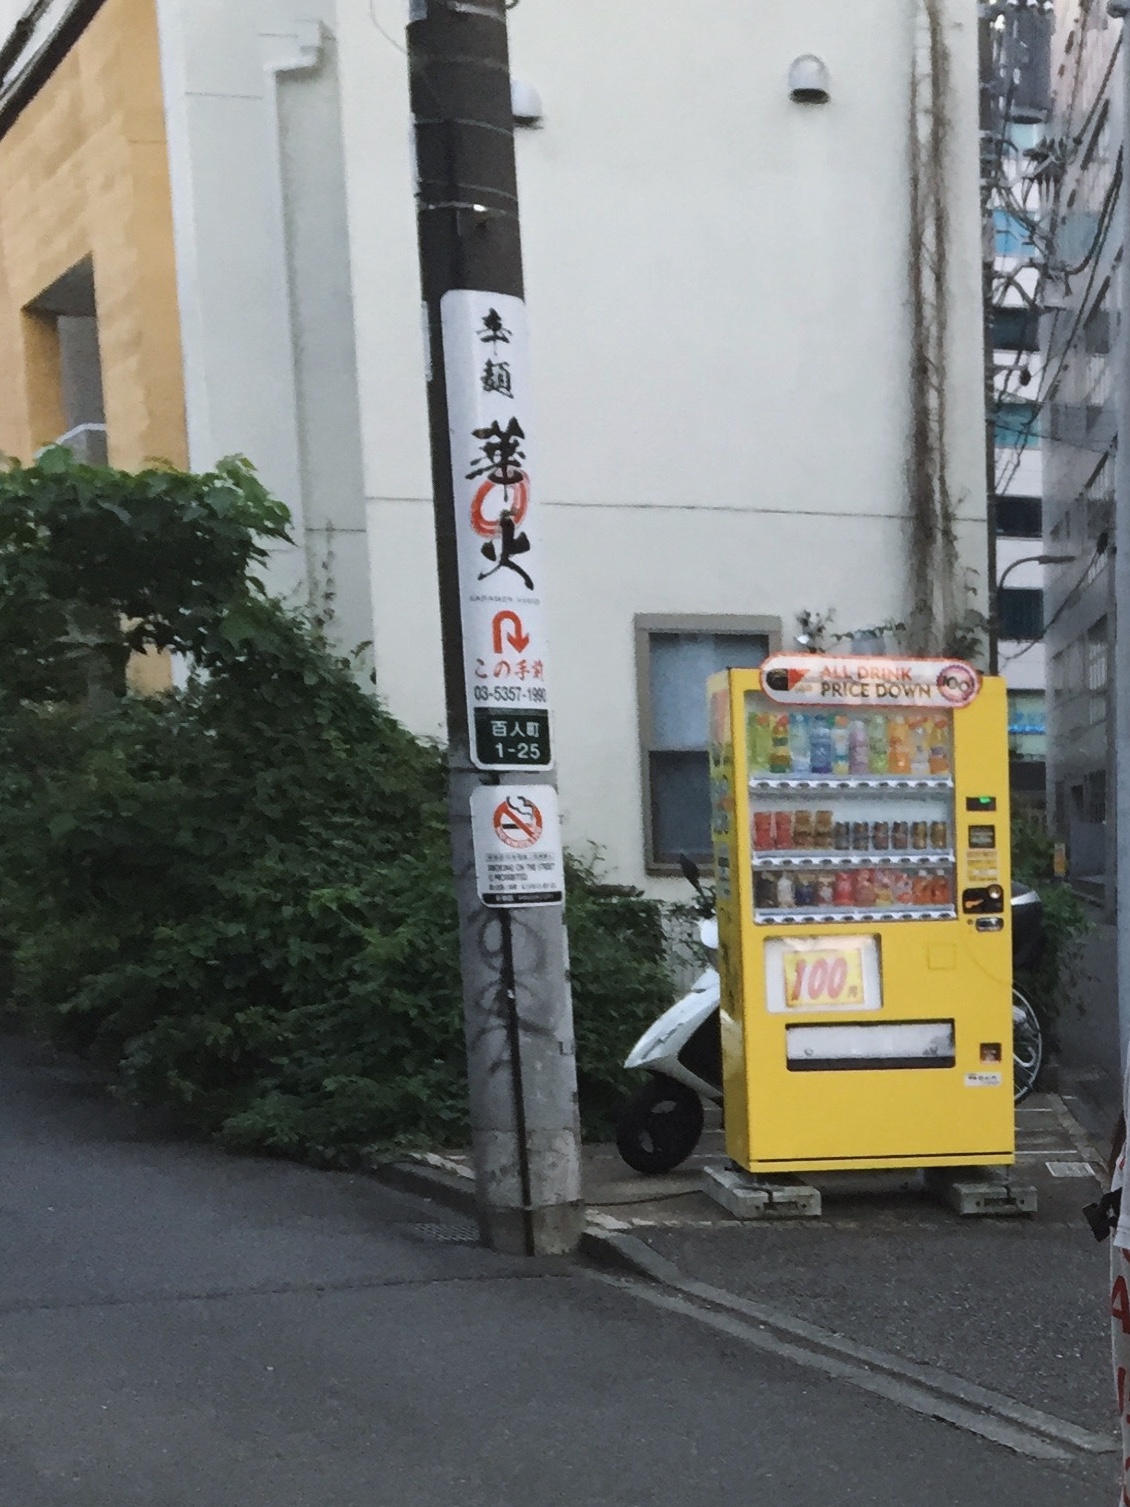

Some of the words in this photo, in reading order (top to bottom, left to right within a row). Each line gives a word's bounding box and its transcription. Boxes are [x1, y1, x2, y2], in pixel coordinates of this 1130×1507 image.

[820, 664, 849, 680] ALL
[857, 665, 913, 681] DRINK
[821, 681, 870, 698] PRICE
[876, 682, 931, 699] DOWN
[490, 720, 540, 737] 百人町
[495, 742, 540, 759] 1-25
